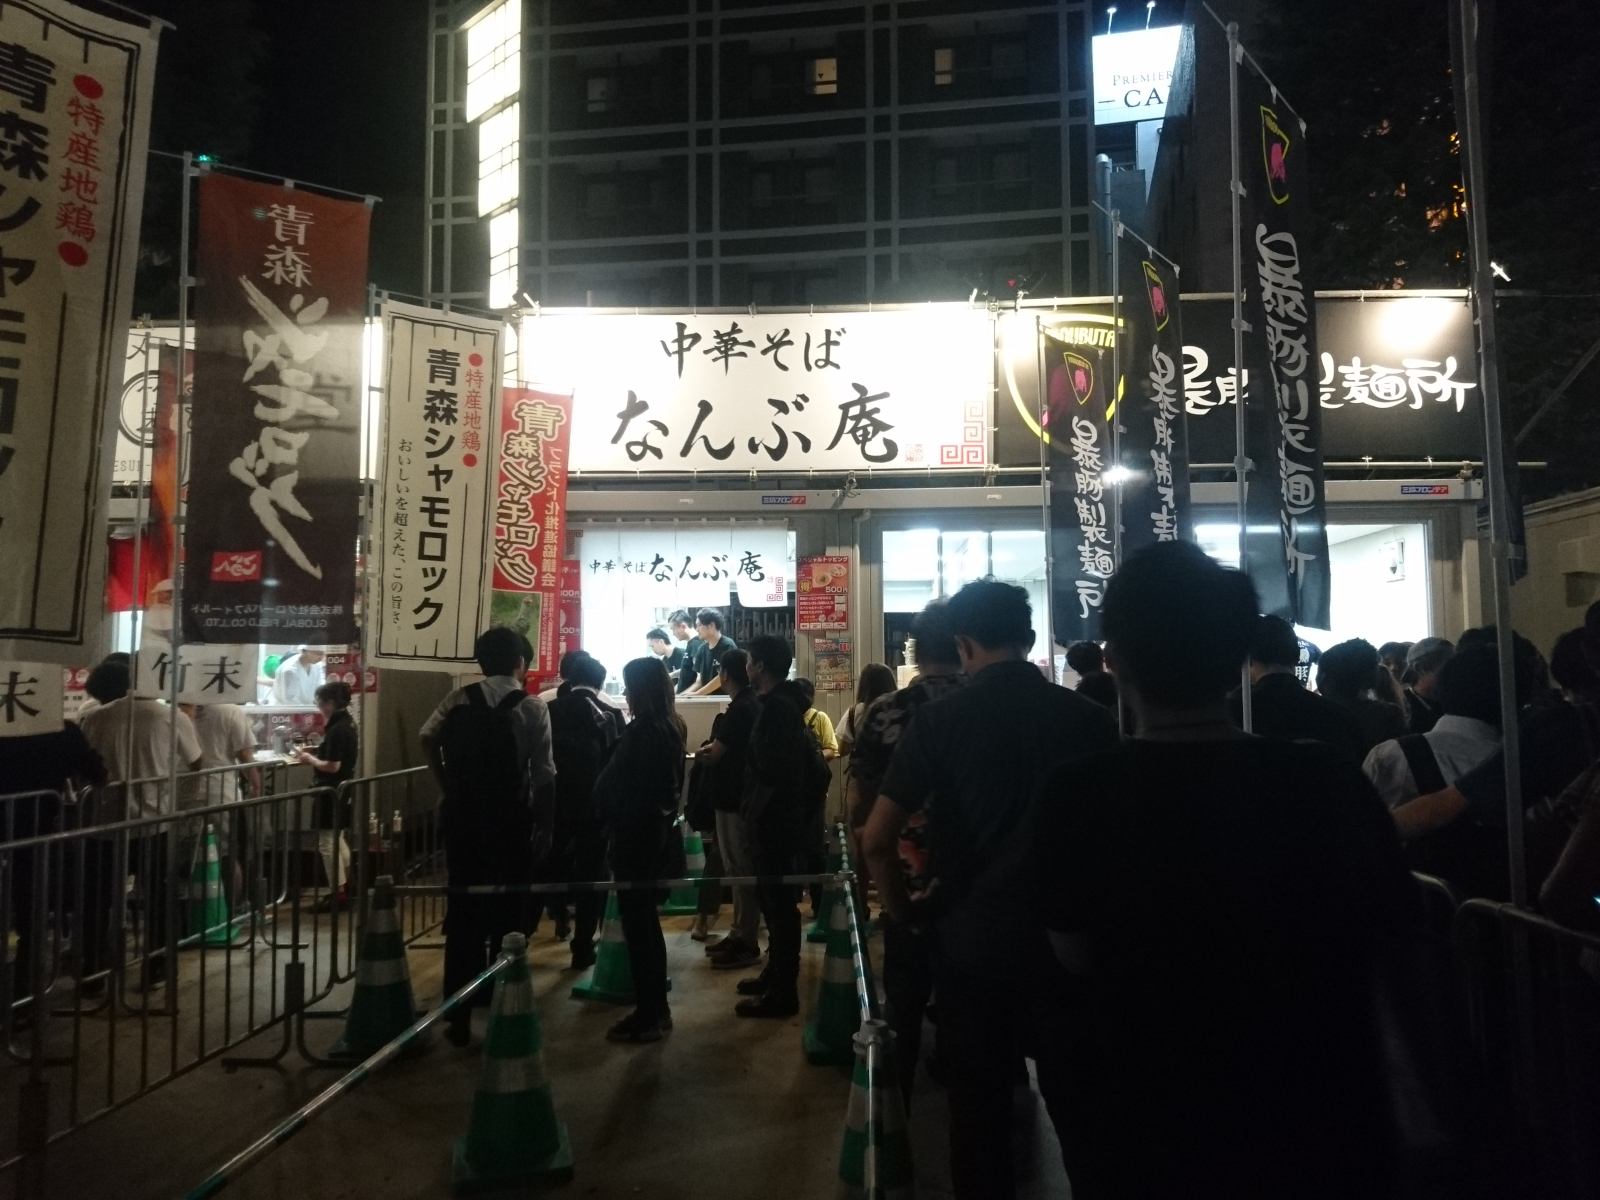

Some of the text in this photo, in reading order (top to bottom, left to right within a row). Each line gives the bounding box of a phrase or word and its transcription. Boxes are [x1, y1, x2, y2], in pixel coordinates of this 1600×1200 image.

[1124, 84, 1171, 108] CA
[55, 96, 105, 243] 特産地鶏
[659, 320, 847, 379] 中華そば
[461, 368, 483, 452] 特産地鶏
[610, 383, 899, 463] なんぶ庵
[412, 348, 461, 630] 青森シャモロック
[391, 438, 413, 632] おいしいを超えた、この旨さ。
[648, 551, 766, 583] なんぶ庵
[328, 656, 345, 664] 004
